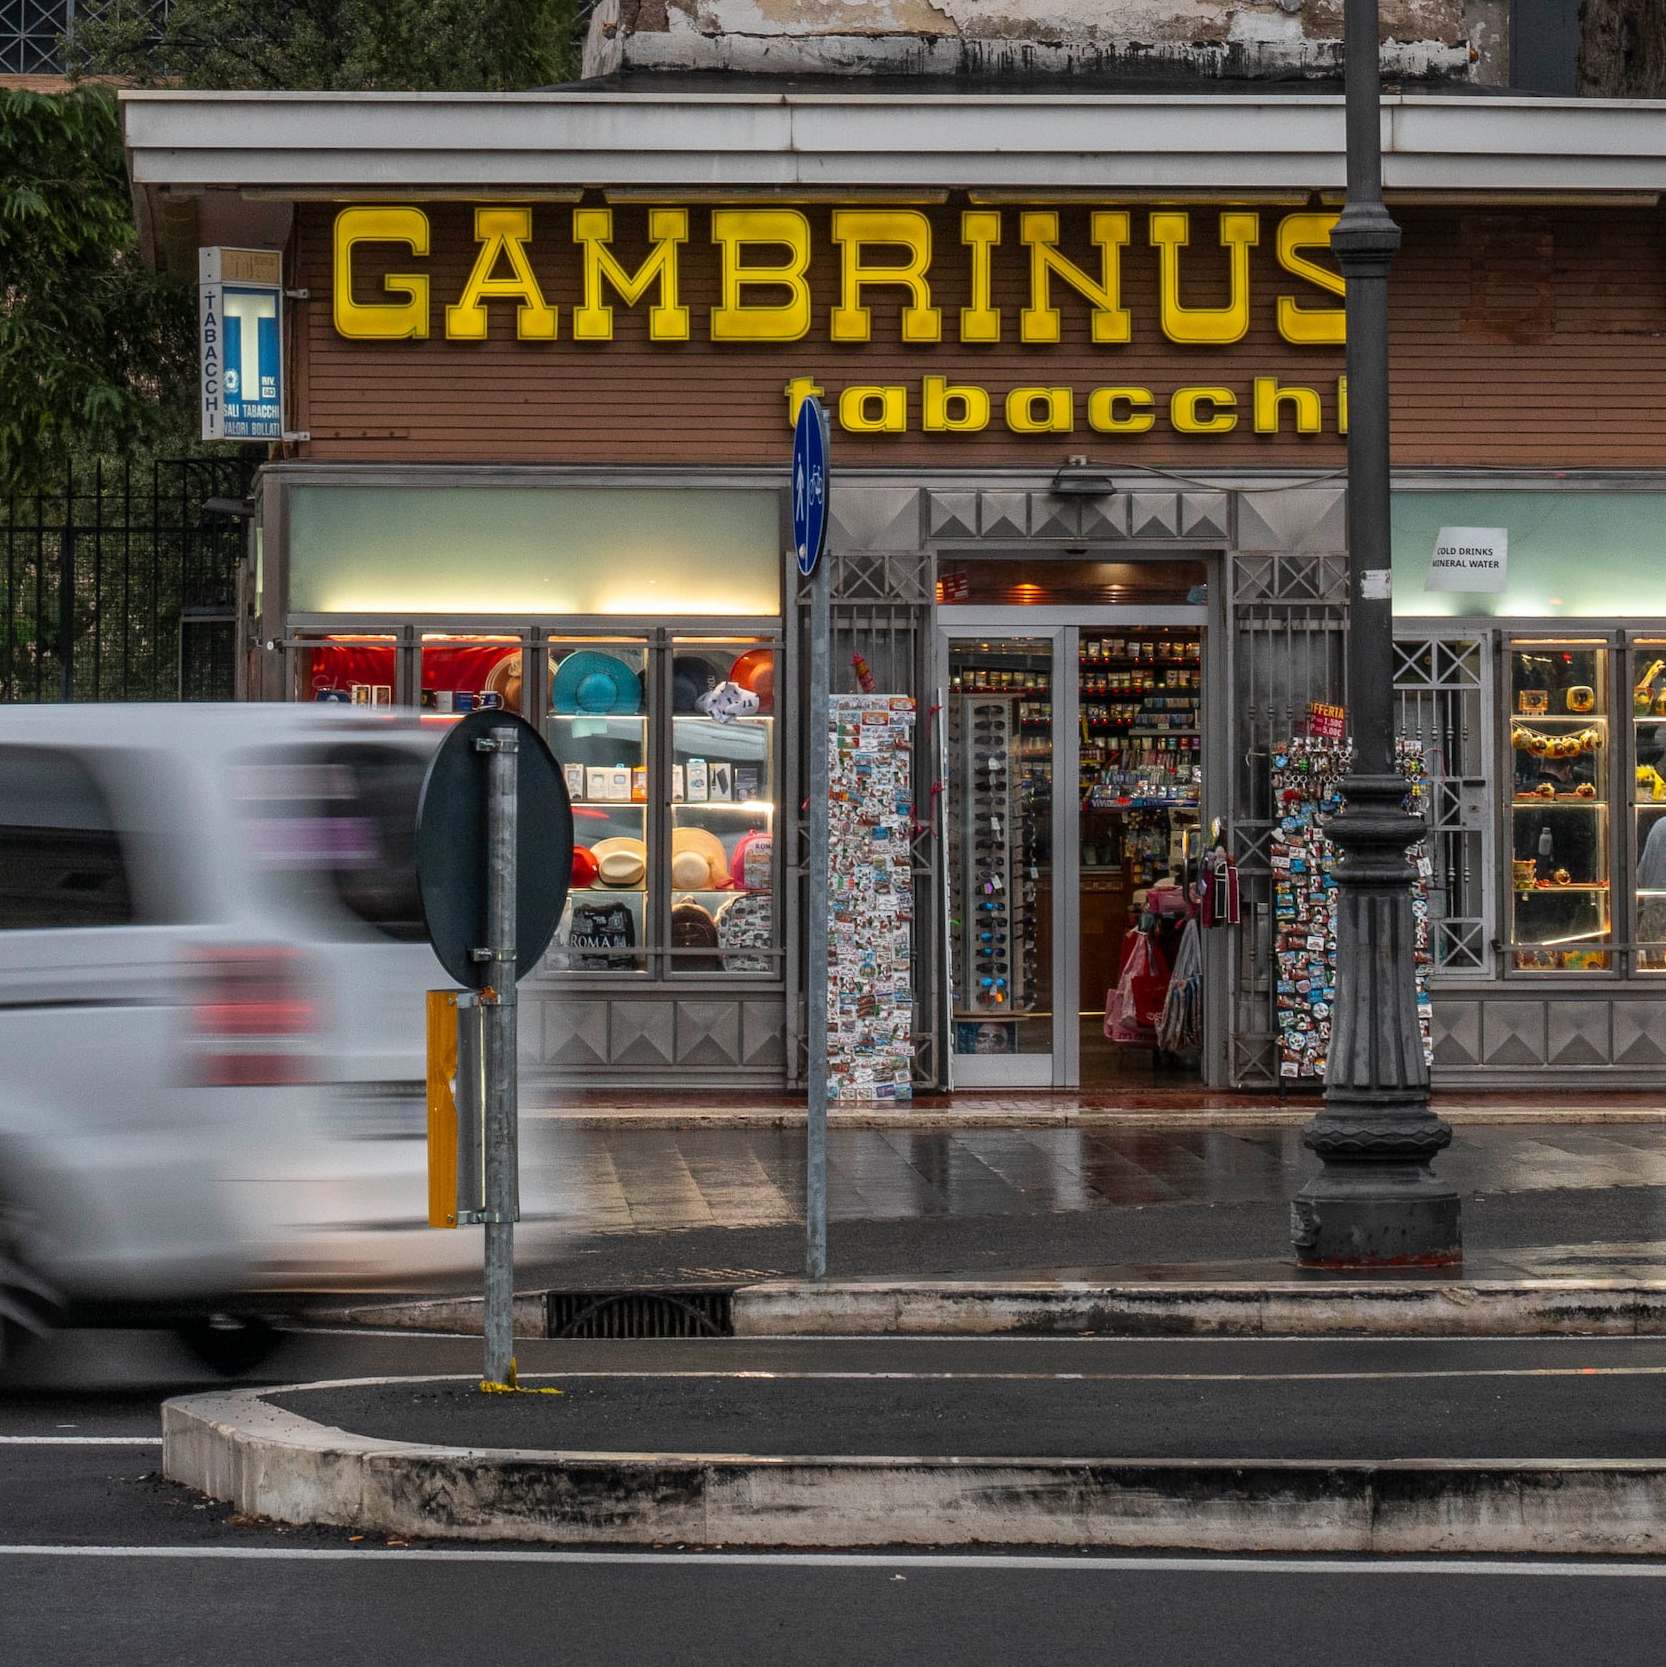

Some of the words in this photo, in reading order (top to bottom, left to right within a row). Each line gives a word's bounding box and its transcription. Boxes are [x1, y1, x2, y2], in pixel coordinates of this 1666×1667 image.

[333, 206, 1347, 346] GAMBRINUS
[223, 292, 276, 401] T
[204, 294, 218, 428] TABACCHI
[242, 404, 279, 419] TABACCHI
[251, 422, 280, 437] BOLLATI
[1438, 547, 1457, 555] COLD
[1459, 547, 1493, 556] DRINKS
[1469, 560, 1500, 569] WATER
[570, 934, 611, 948] ROMA
